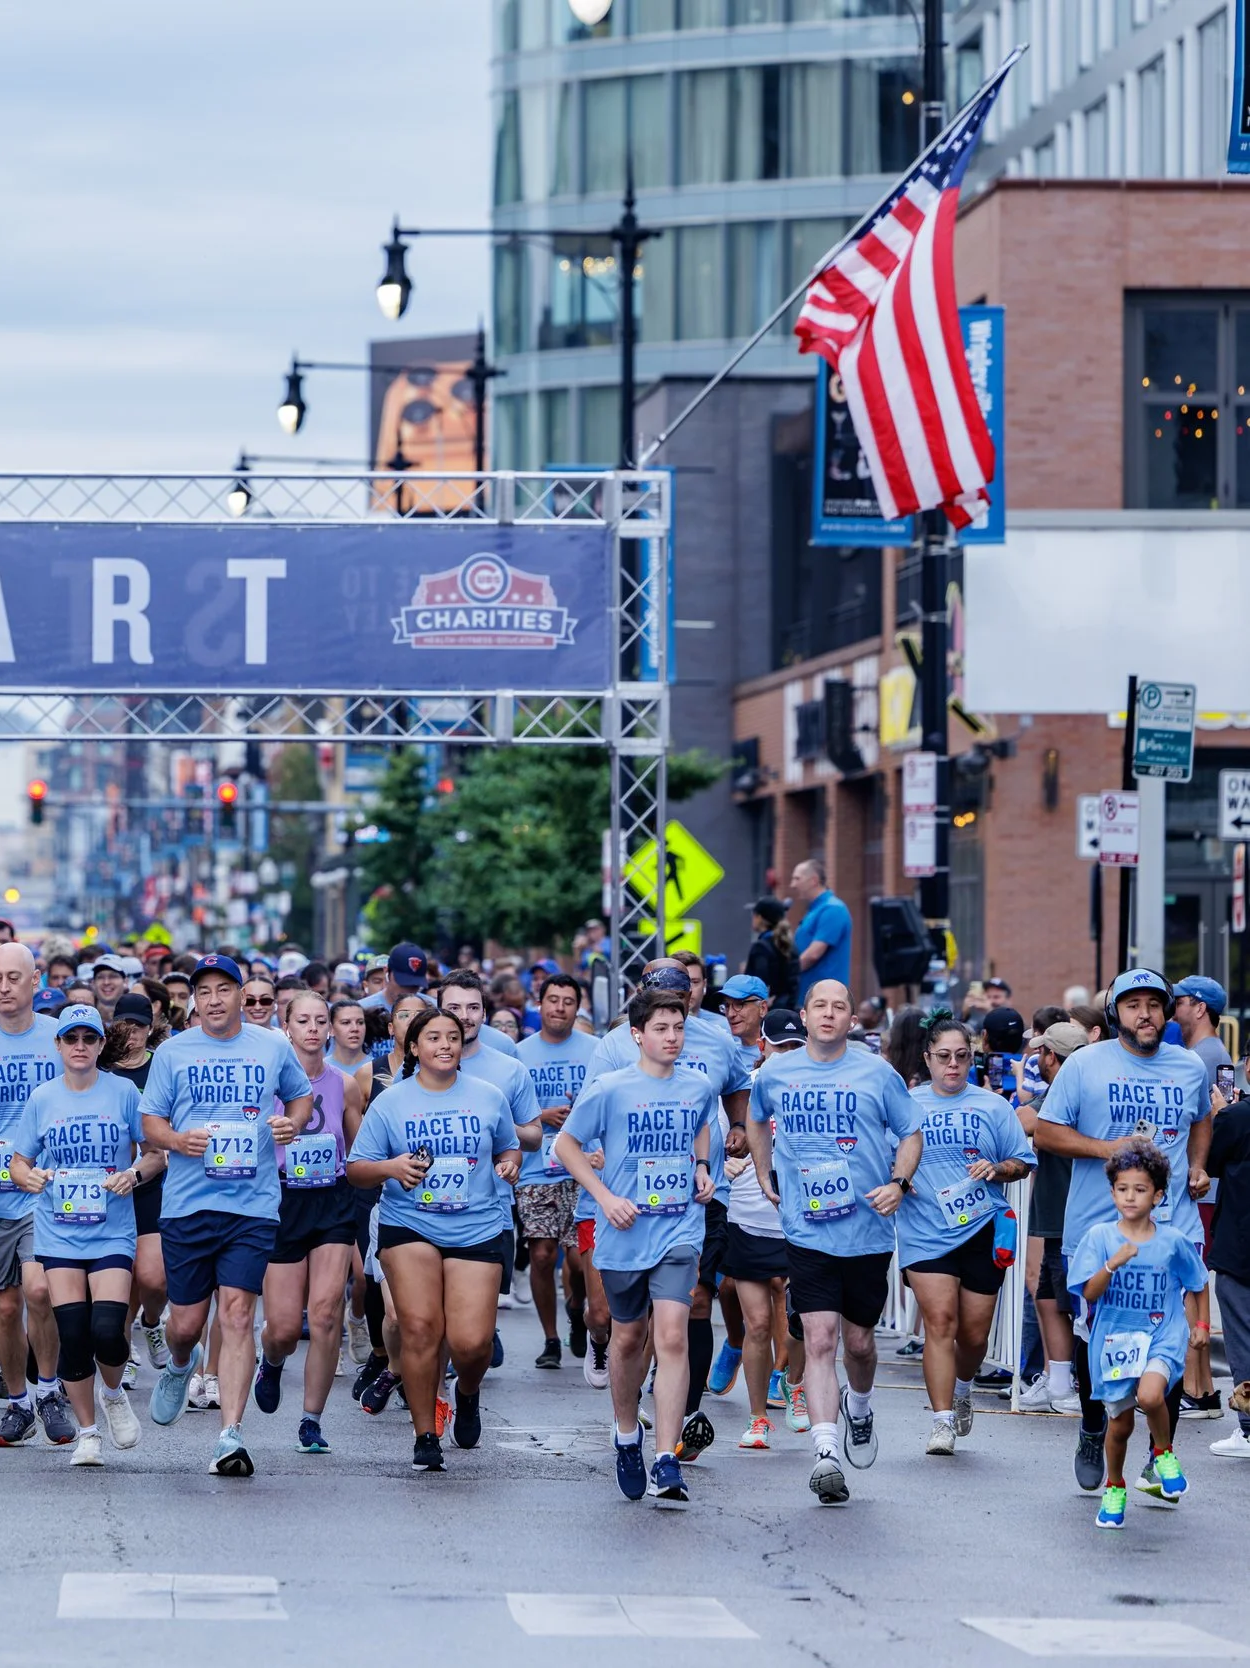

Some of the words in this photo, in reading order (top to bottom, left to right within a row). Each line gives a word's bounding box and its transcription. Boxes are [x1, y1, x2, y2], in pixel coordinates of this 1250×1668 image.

[416, 609, 553, 631] CHARITIES
[34, 1062, 55, 1081] TO
[188, 1065, 236, 1084] RACE
[242, 1065, 265, 1084] TO
[529, 1067, 565, 1082] RACE
[569, 1065, 586, 1080] TO
[190, 1086, 264, 1103] WRIGLEY
[782, 1091, 827, 1112] RACE
[834, 1091, 857, 1113] TO
[1109, 1083, 1154, 1104] RACE
[1161, 1087, 1183, 1105] TO
[628, 1110, 674, 1133] RACE
[680, 1110, 698, 1131] TO
[783, 1114, 857, 1134] WRIGLEY
[921, 1113, 953, 1130] ACE
[961, 1113, 980, 1129] TO
[1109, 1105, 1183, 1126] WRIGLEY
[49, 1124, 92, 1147] RACE
[100, 1123, 119, 1143] TO
[405, 1117, 451, 1140] RACE
[458, 1116, 481, 1134] TO
[923, 1129, 981, 1146] RIGLEY
[51, 1145, 119, 1165] WRIGLEY
[211, 1138, 253, 1153] 1712
[216, 1156, 223, 1164] C
[292, 1149, 332, 1165] 1429
[421, 1174, 464, 1189] 1679
[644, 1173, 687, 1190] 1695
[803, 1177, 849, 1197] 1660
[59, 1184, 100, 1199] 1713
[424, 1193, 431, 1201] C
[650, 1196, 658, 1204] C
[945, 1188, 985, 1215] 1930
[1152, 1272, 1167, 1291] TO
[1104, 1290, 1166, 1310] WRIGLEY
[1106, 1348, 1140, 1366] 1931
[1112, 1369, 1119, 1377] C
